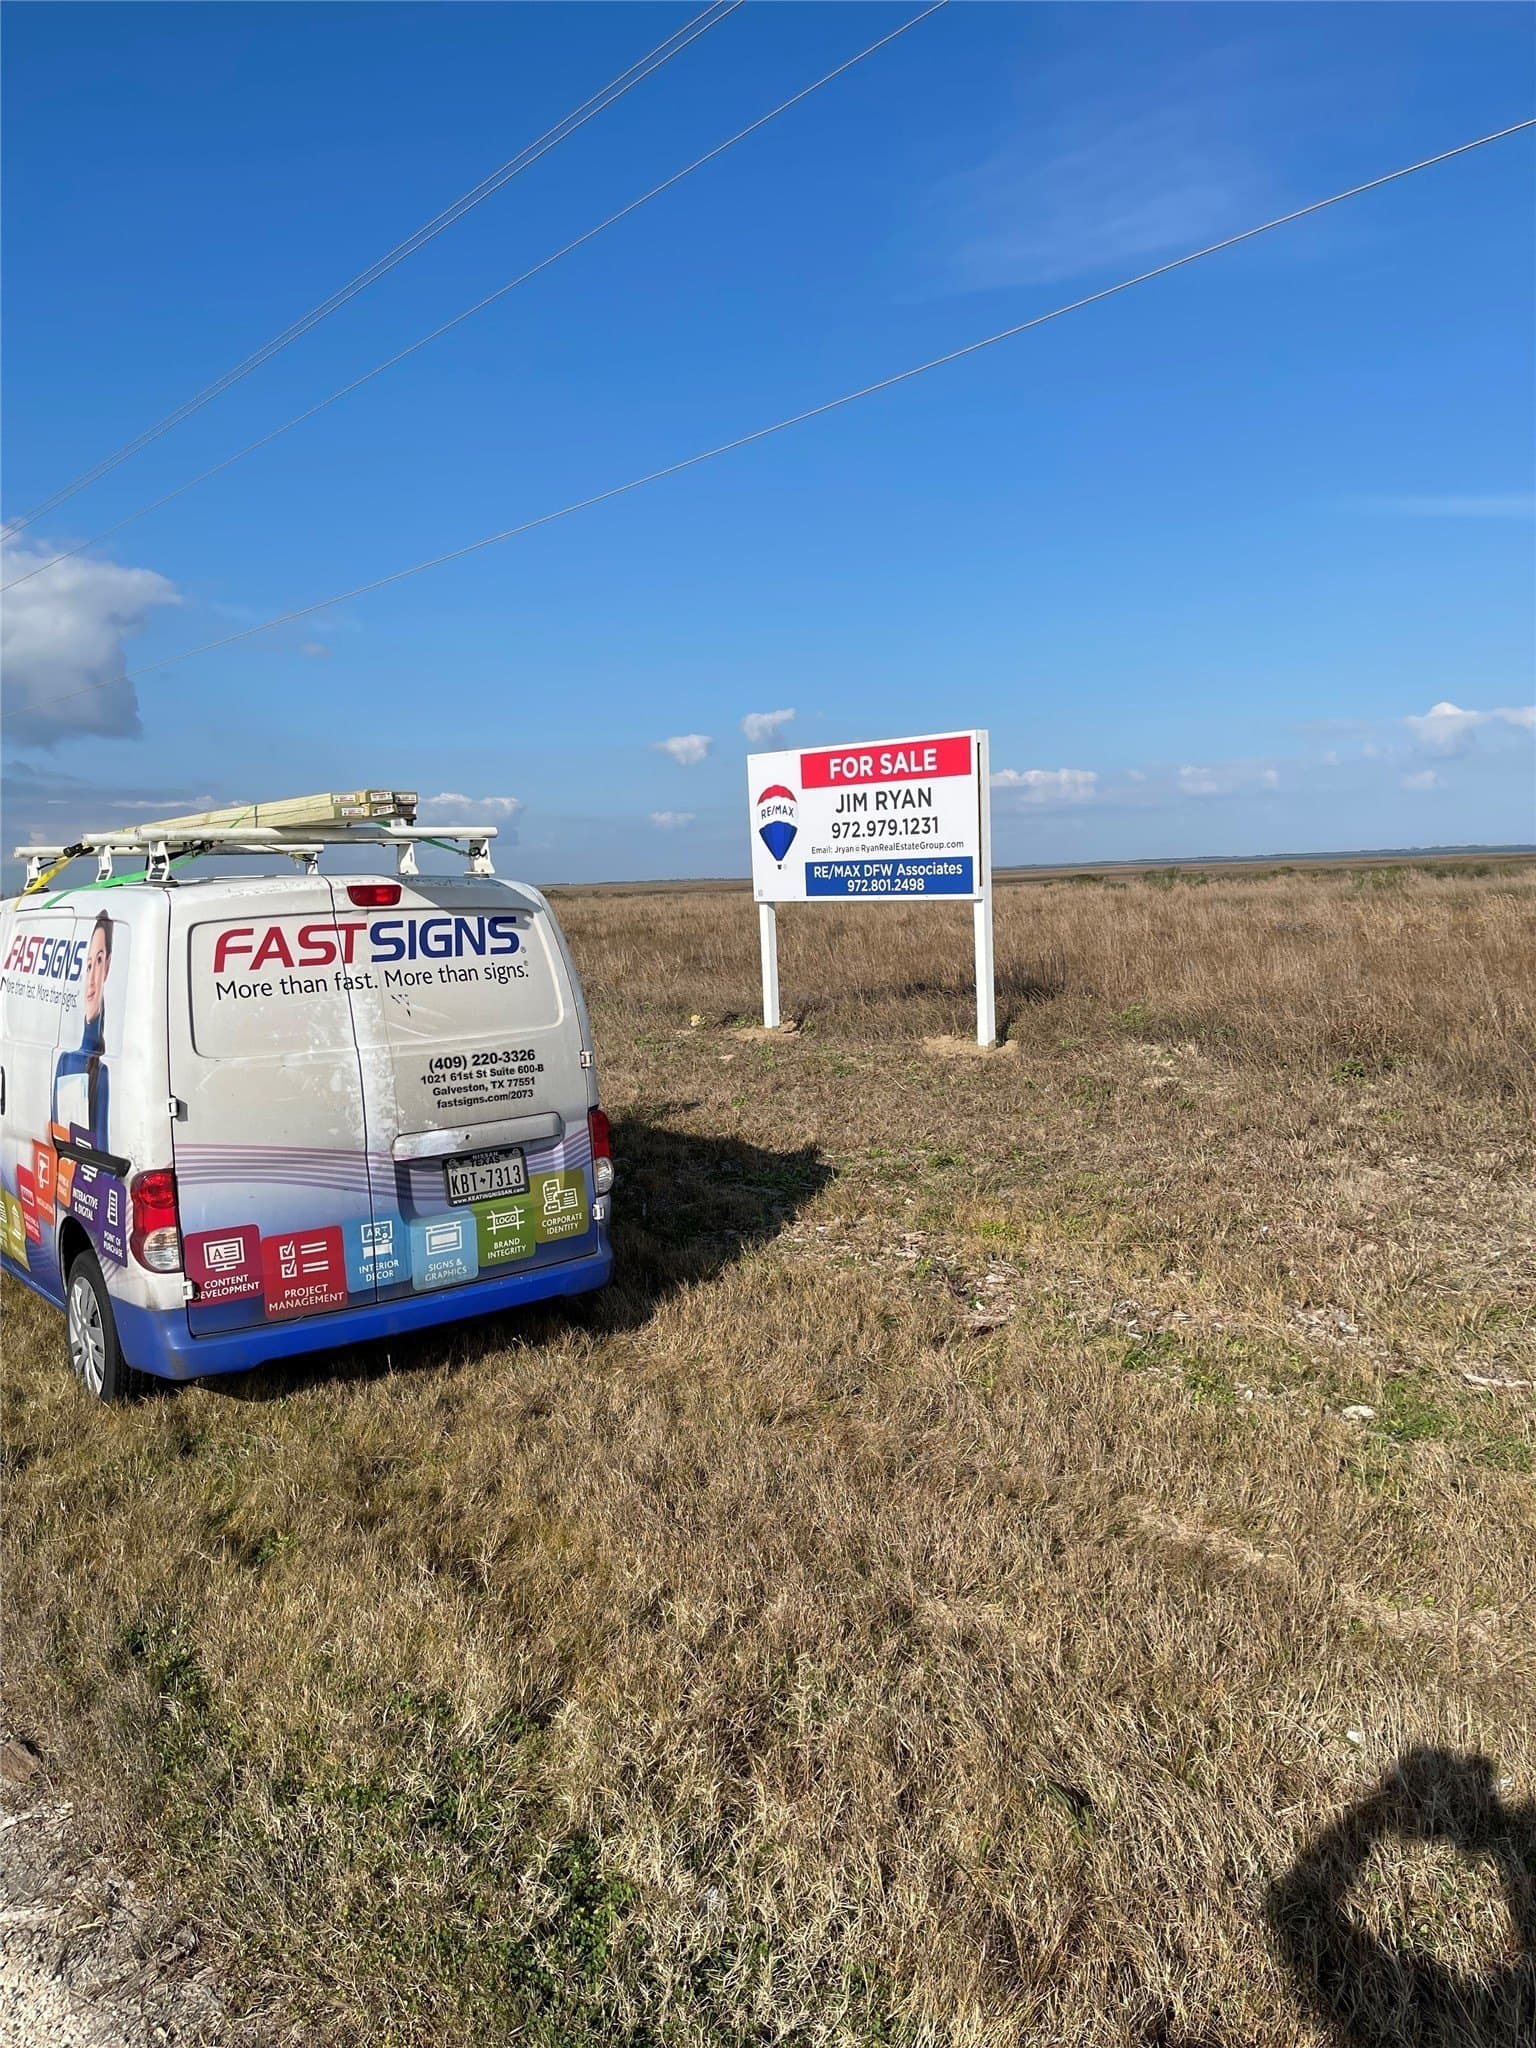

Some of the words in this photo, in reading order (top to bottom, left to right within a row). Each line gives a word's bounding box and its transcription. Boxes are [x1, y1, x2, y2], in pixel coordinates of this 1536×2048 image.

[829, 758, 873, 780] FOR
[880, 748, 937, 775] SALE
[835, 792, 868, 814] JIM
[875, 787, 932, 811] RYAN
[761, 804, 795, 820] RE/MAX
[831, 816, 939, 839] 972.979.1231
[811, 845, 834, 855] Email:
[813, 864, 861, 879] RE/MAX
[863, 863, 893, 877] DFW
[896, 861, 963, 877] Associates
[847, 878, 925, 892] 972.801.2498
[213, 916, 521, 973] FASTSIGNS
[4, 935, 88, 982] FASTSIGNS
[216, 980, 273, 1001] More
[280, 975, 328, 994] than
[335, 971, 379, 991] fast.
[384, 969, 433, 988] More
[438, 964, 479, 984] than
[484, 962, 529, 984] signs.
[429, 1055, 467, 1074] (409)
[472, 1049, 536, 1066] 220-3326
[421, 1074, 446, 1085] 1021
[450, 1071, 473, 1082] 61st
[476, 1069, 487, 1079] St
[490, 1066, 515, 1078] Suite
[518, 1064, 544, 1074] 600-B
[432, 1083, 489, 1096] Galveston,
[491, 1080, 505, 1090] TX
[507, 1076, 535, 1088] 77551
[437, 1089, 534, 1109] fastsigns.com/2073
[470, 1155, 500, 1167] TEXAS
[472, 1151, 499, 1160] NISSAN
[495, 1215, 516, 1225] LOGO
[541, 1212, 583, 1227] CORPORATE
[546, 1222, 579, 1235] IDENTITY
[493, 1237, 520, 1250] BRAND
[487, 1244, 527, 1260] INTEGRITY
[359, 1259, 400, 1274] INTERIOR
[428, 1260, 454, 1272] SIGNS
[455, 1258, 463, 1266] &
[204, 1273, 249, 1289] CONTENT
[424, 1266, 467, 1282] GRAPHICS
[198, 1281, 261, 1300] EVELOPMENT
[284, 1283, 328, 1299] PROJECT
[268, 1291, 345, 1312] MANAGEMENT
